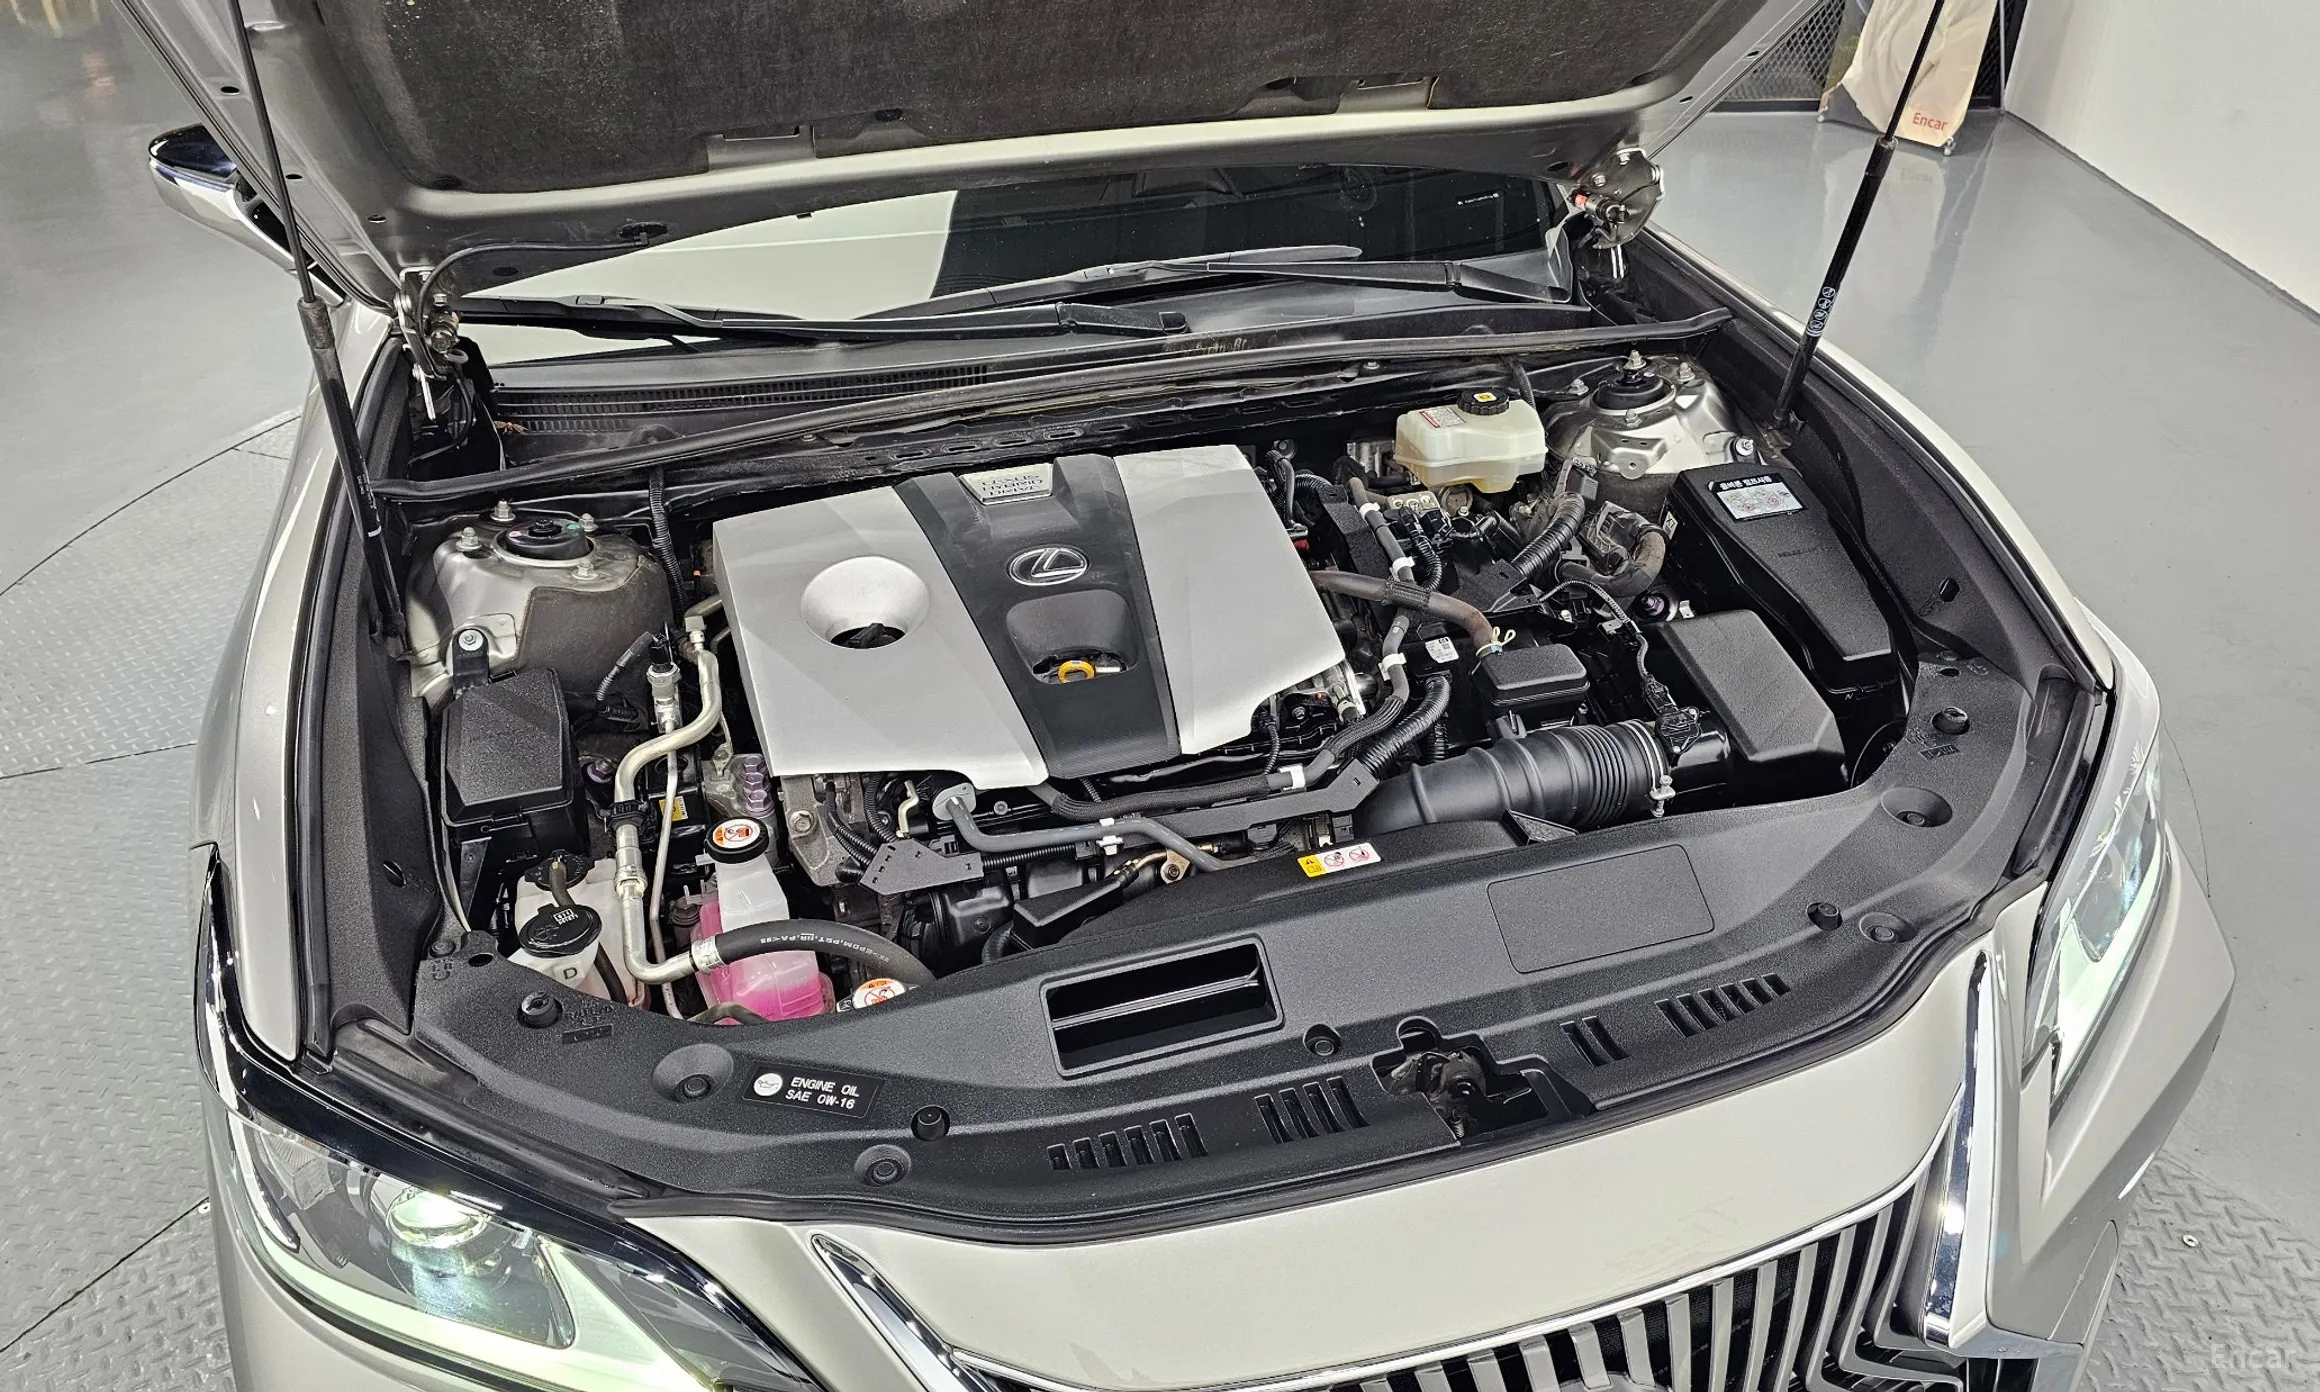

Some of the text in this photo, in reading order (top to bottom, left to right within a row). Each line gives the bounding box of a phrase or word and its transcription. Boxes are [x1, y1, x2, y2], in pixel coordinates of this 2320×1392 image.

[1912, 112, 1948, 131] Encar
[790, 1077, 860, 1098] ENGINE OIL
[785, 1089, 856, 1109] SAE 0W-16
